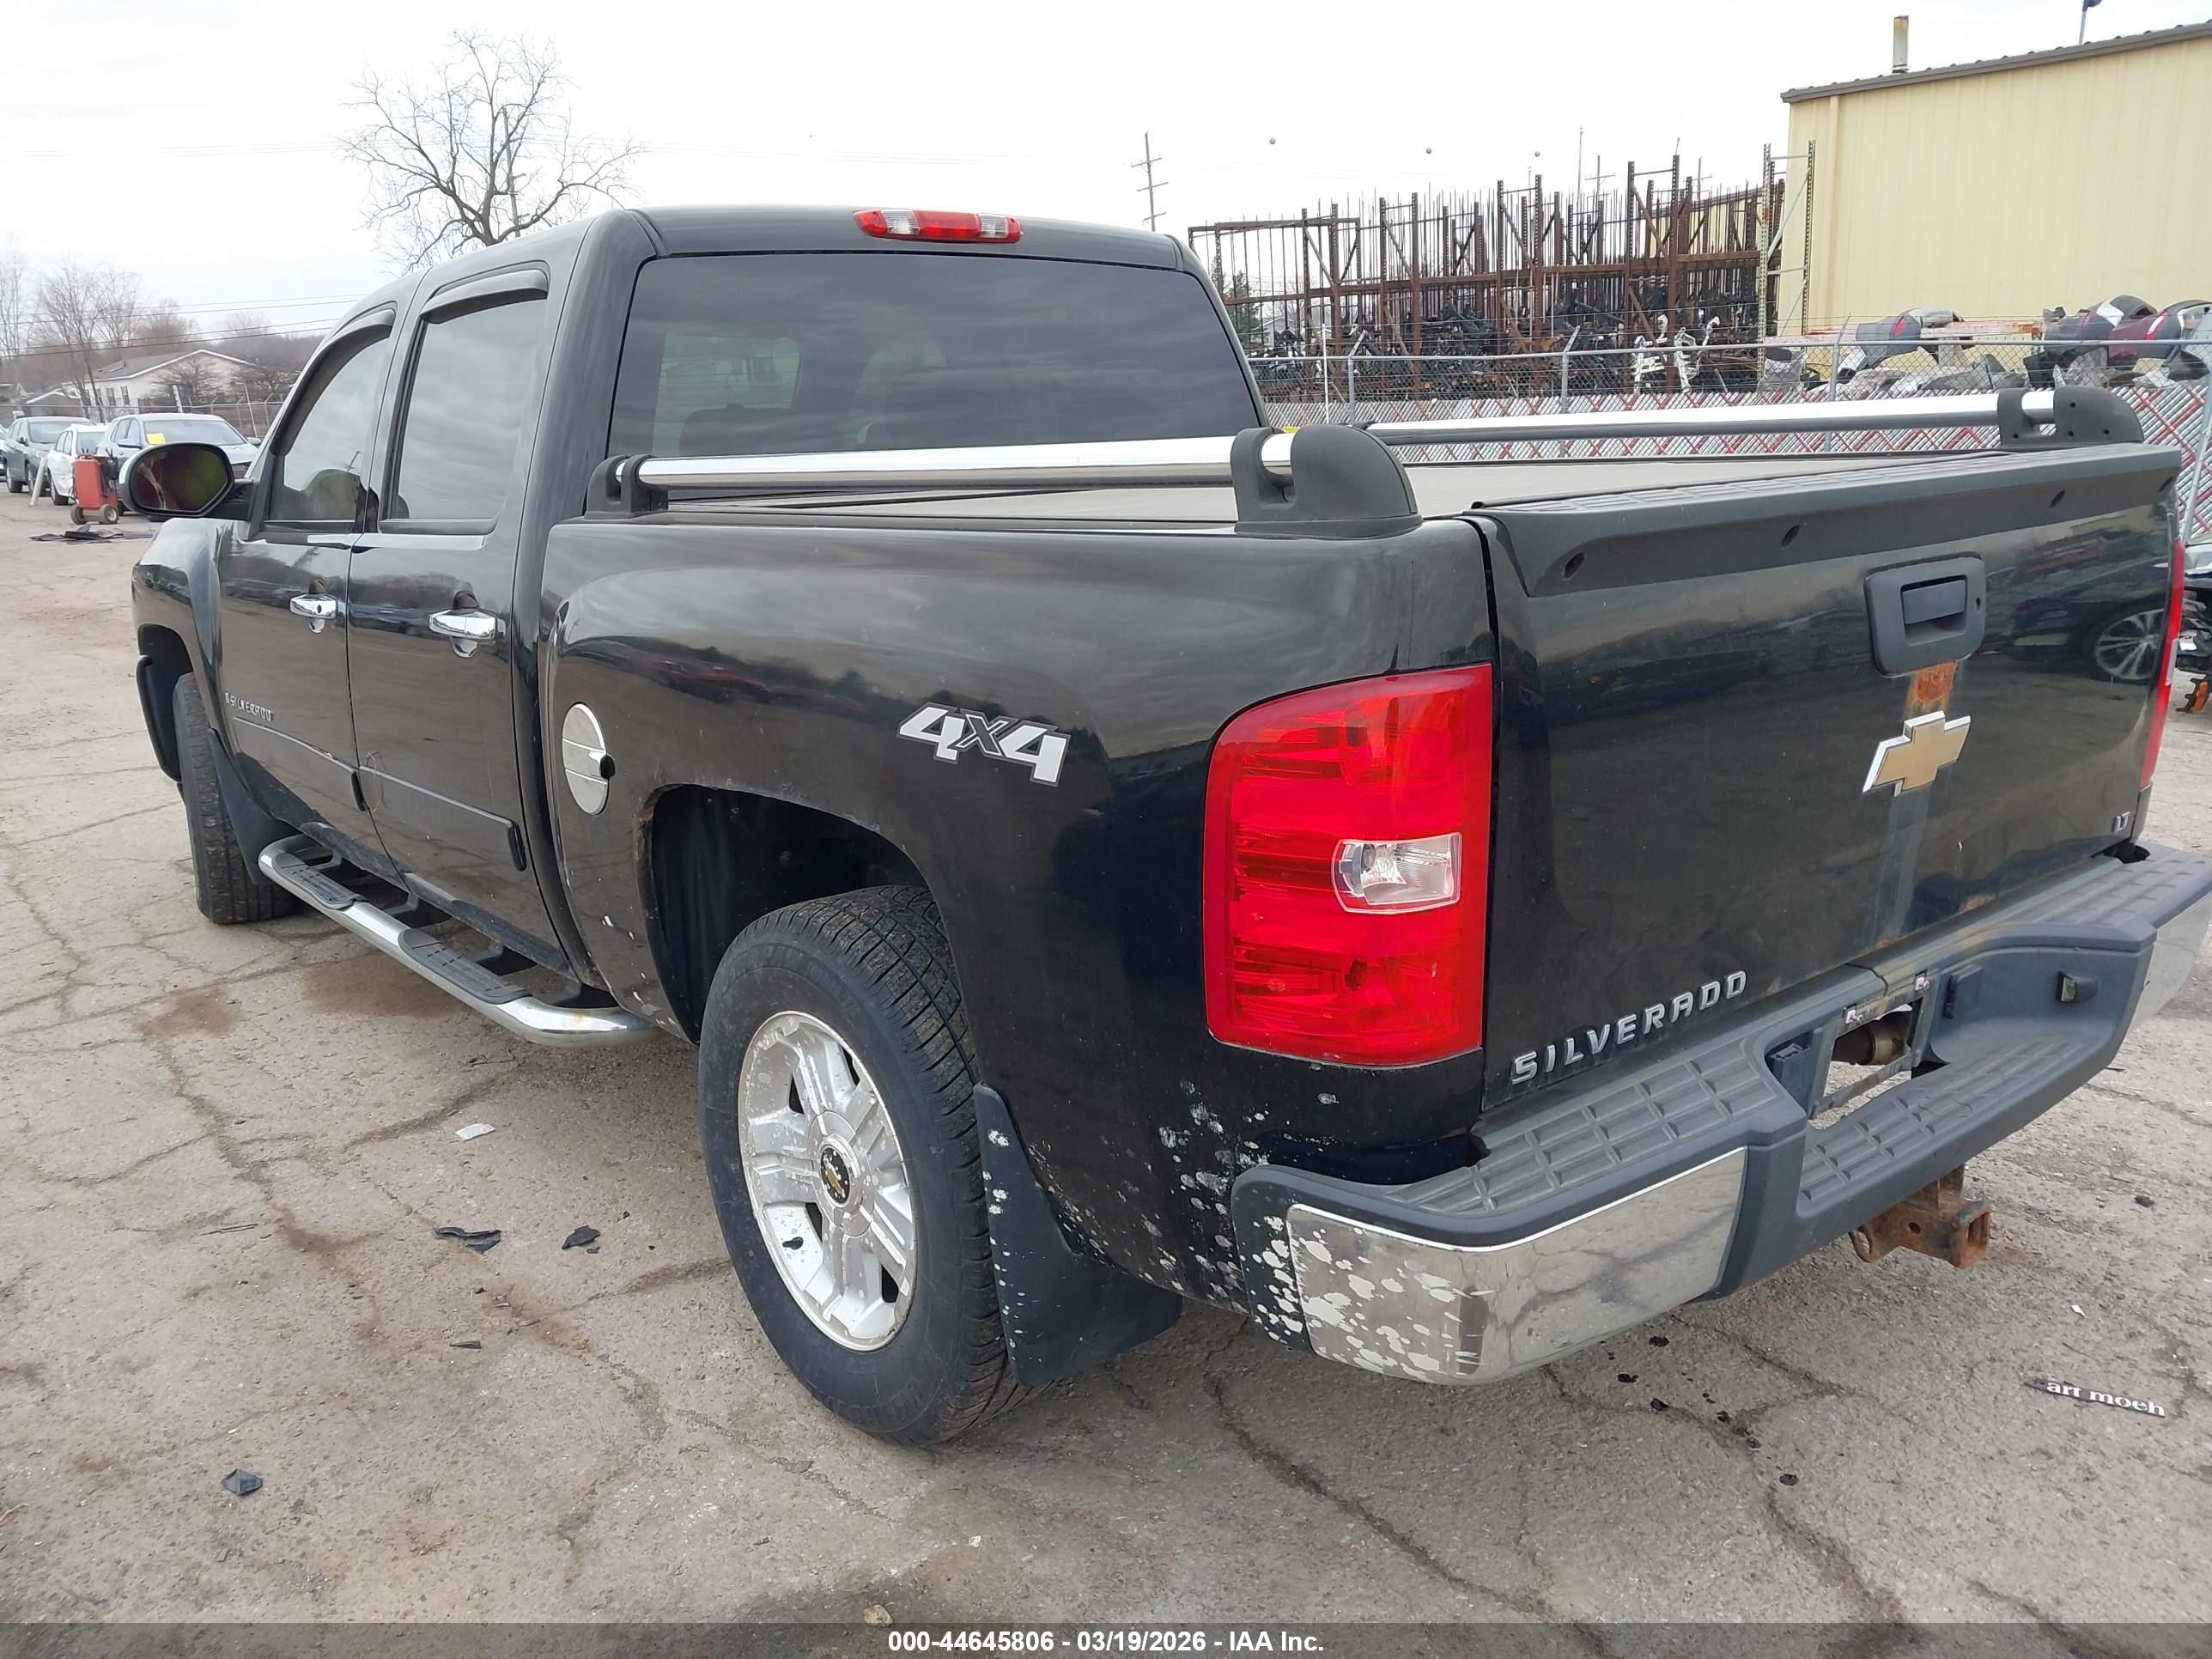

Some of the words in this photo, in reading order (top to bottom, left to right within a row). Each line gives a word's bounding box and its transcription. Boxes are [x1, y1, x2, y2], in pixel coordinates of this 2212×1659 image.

[2114, 811, 2130, 833] LT
[1510, 970, 1747, 1085] SILVERADO
[2046, 1381, 2082, 1399] art
[2089, 1390, 2166, 1417] moeh
